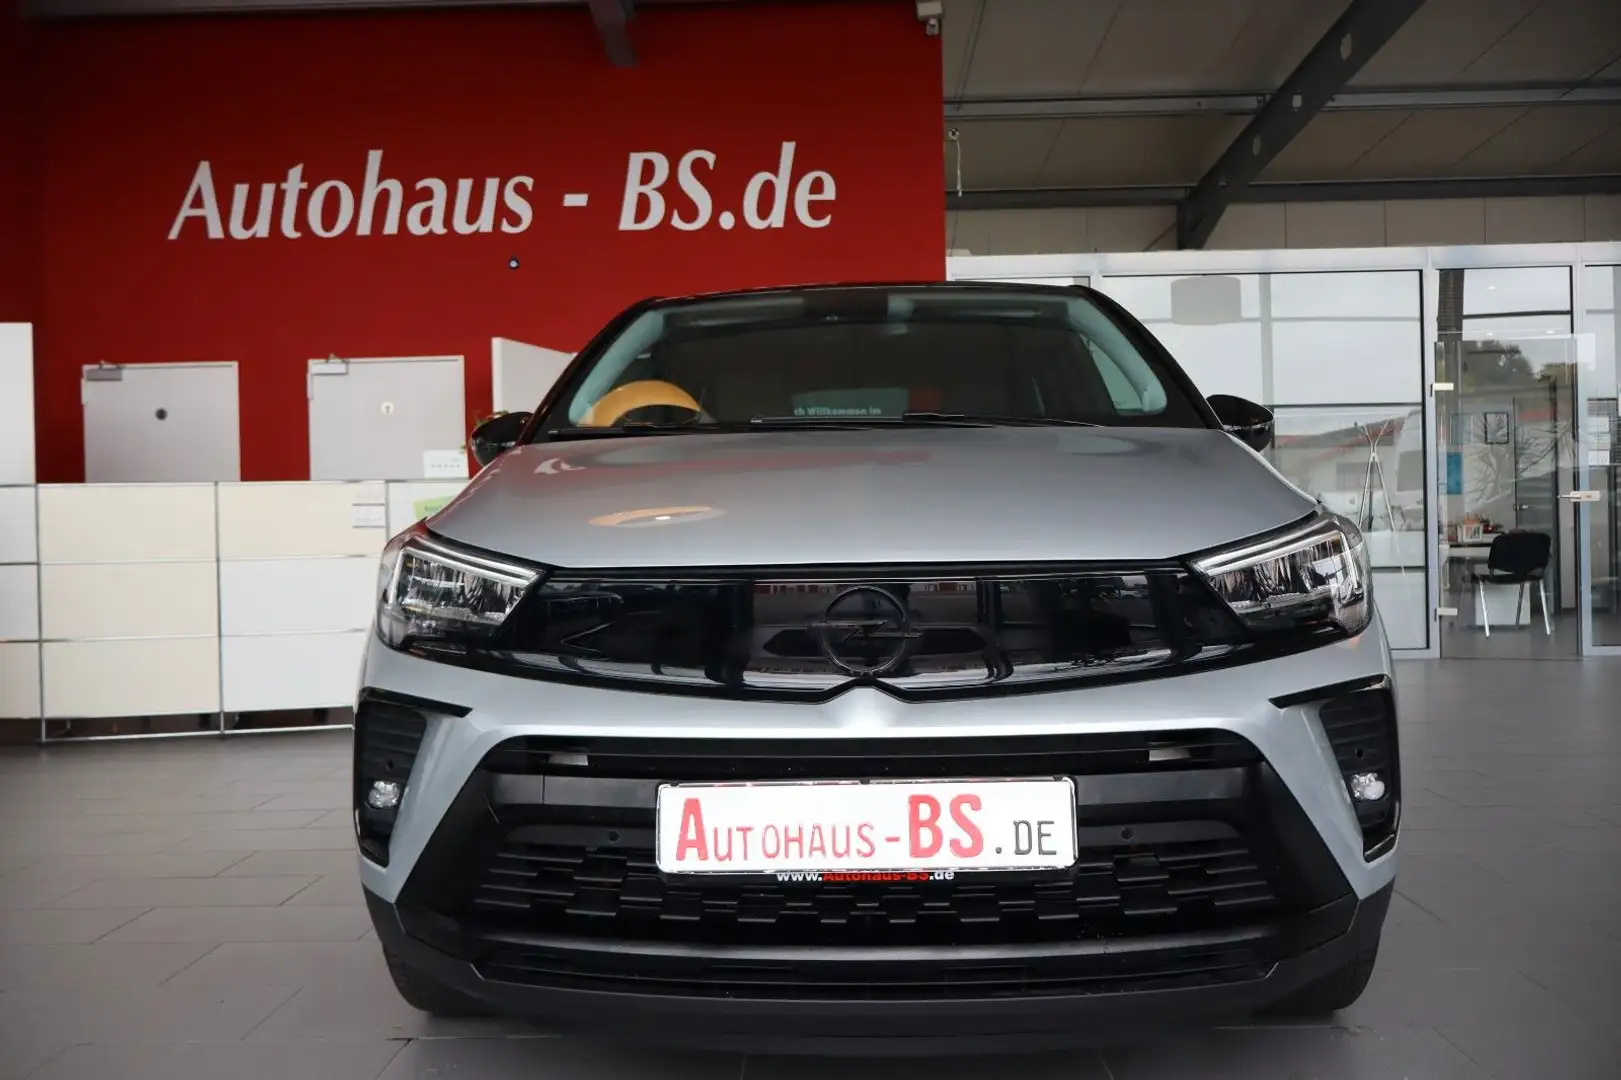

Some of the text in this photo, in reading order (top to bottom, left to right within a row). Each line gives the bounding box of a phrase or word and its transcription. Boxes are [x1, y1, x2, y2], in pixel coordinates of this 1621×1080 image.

[167, 149, 534, 240] Autohaus
[618, 141, 836, 231] BS.de
[807, 406, 868, 416] Willkommen
[776, 870, 955, 882] www.Autohaus-BS.de
